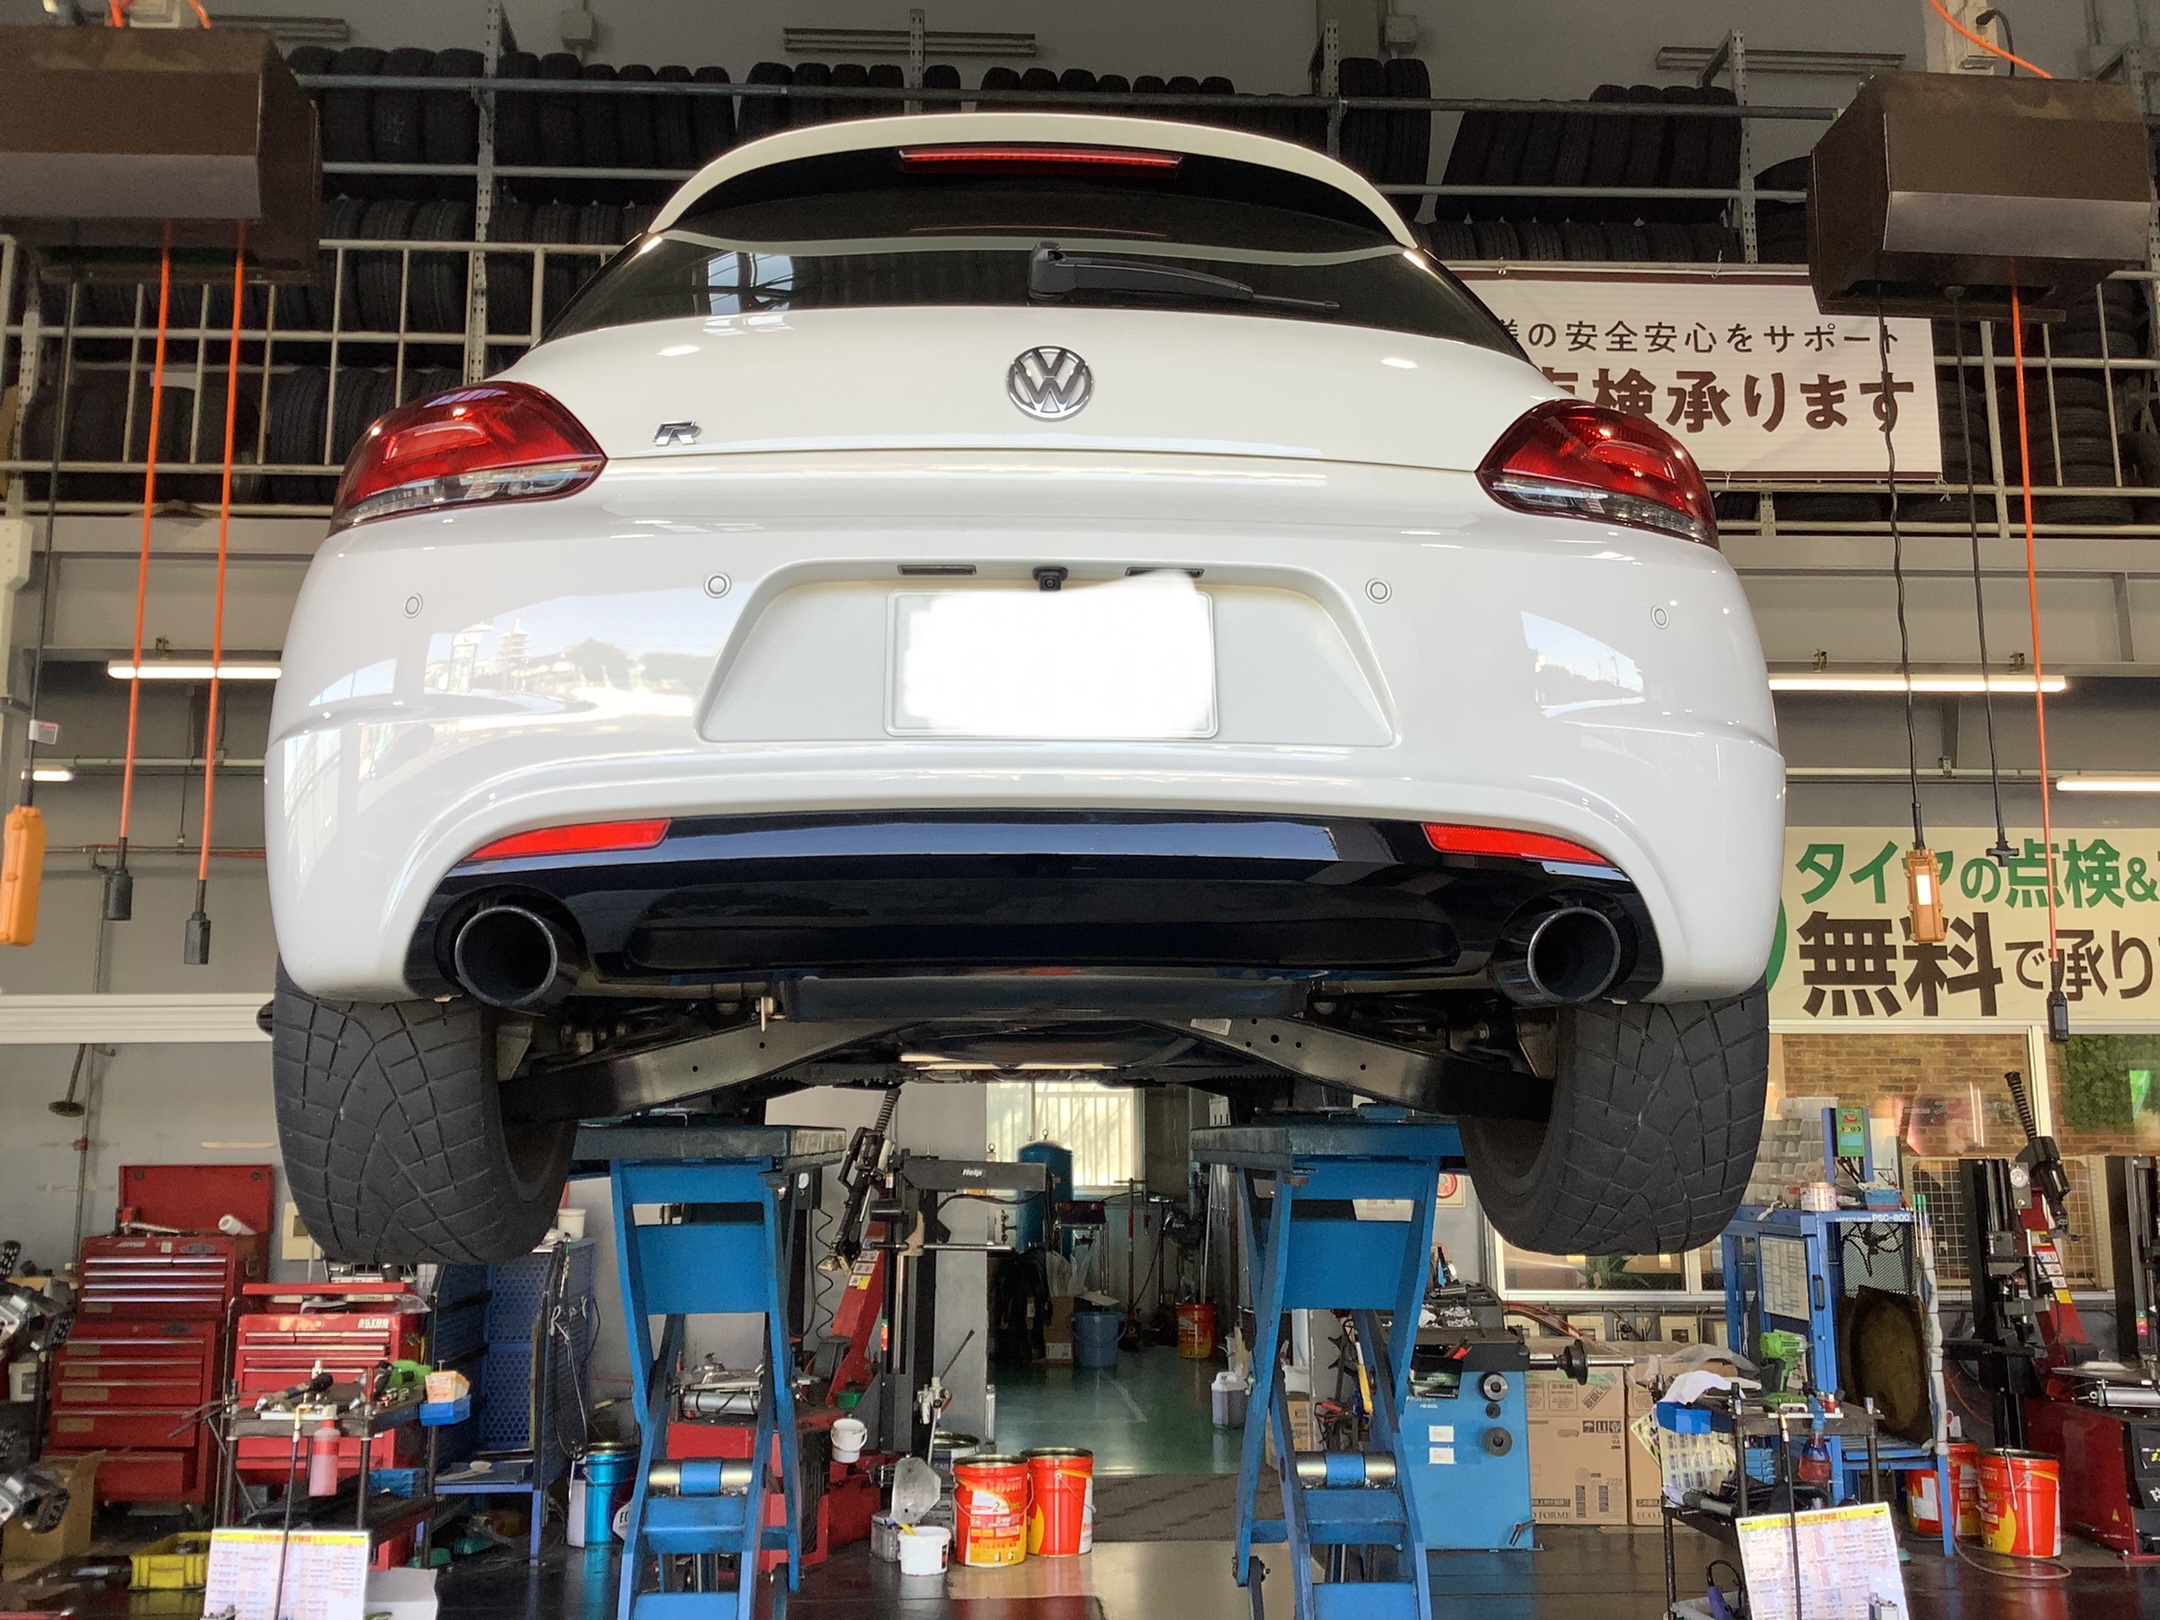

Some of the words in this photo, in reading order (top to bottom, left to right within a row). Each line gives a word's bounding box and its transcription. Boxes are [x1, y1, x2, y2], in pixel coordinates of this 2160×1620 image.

[1796, 911, 2160, 1017] 無料で承り
[962, 1169, 982, 1177] Help
